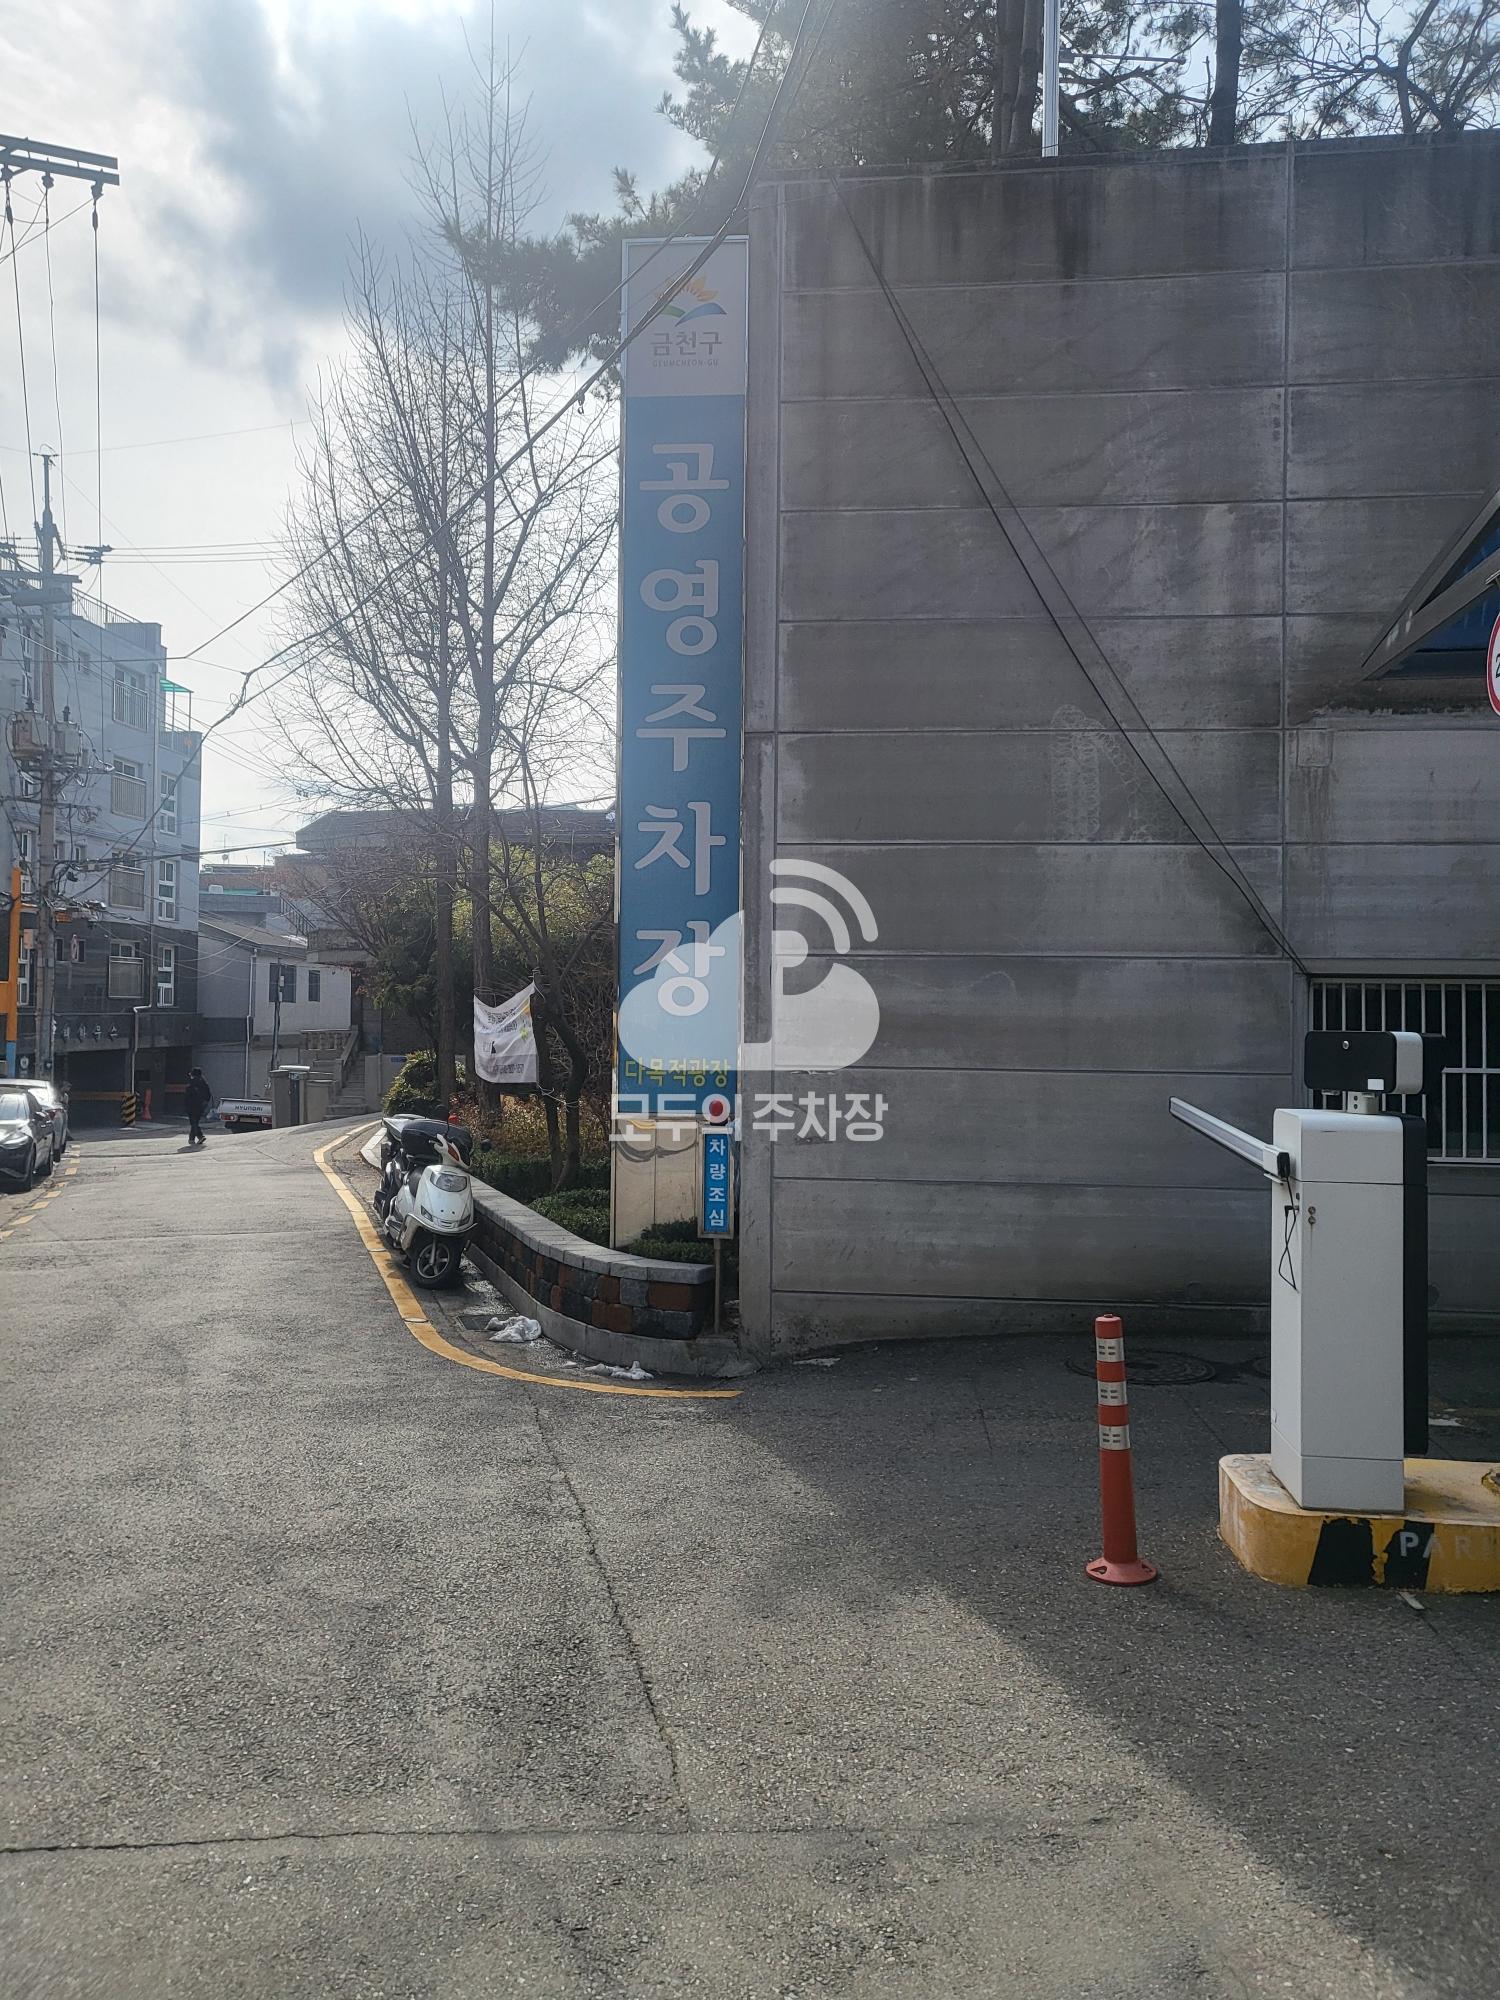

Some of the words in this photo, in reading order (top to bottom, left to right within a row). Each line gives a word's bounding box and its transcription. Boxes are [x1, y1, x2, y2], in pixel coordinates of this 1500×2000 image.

[650, 331, 722, 356] 금천구
[634, 442, 730, 1017] 공영주차장
[625, 1056, 730, 1088] 다목적광장
[234, 1104, 264, 1112] HYUNDAI
[708, 1138, 726, 1227] 차량조심
